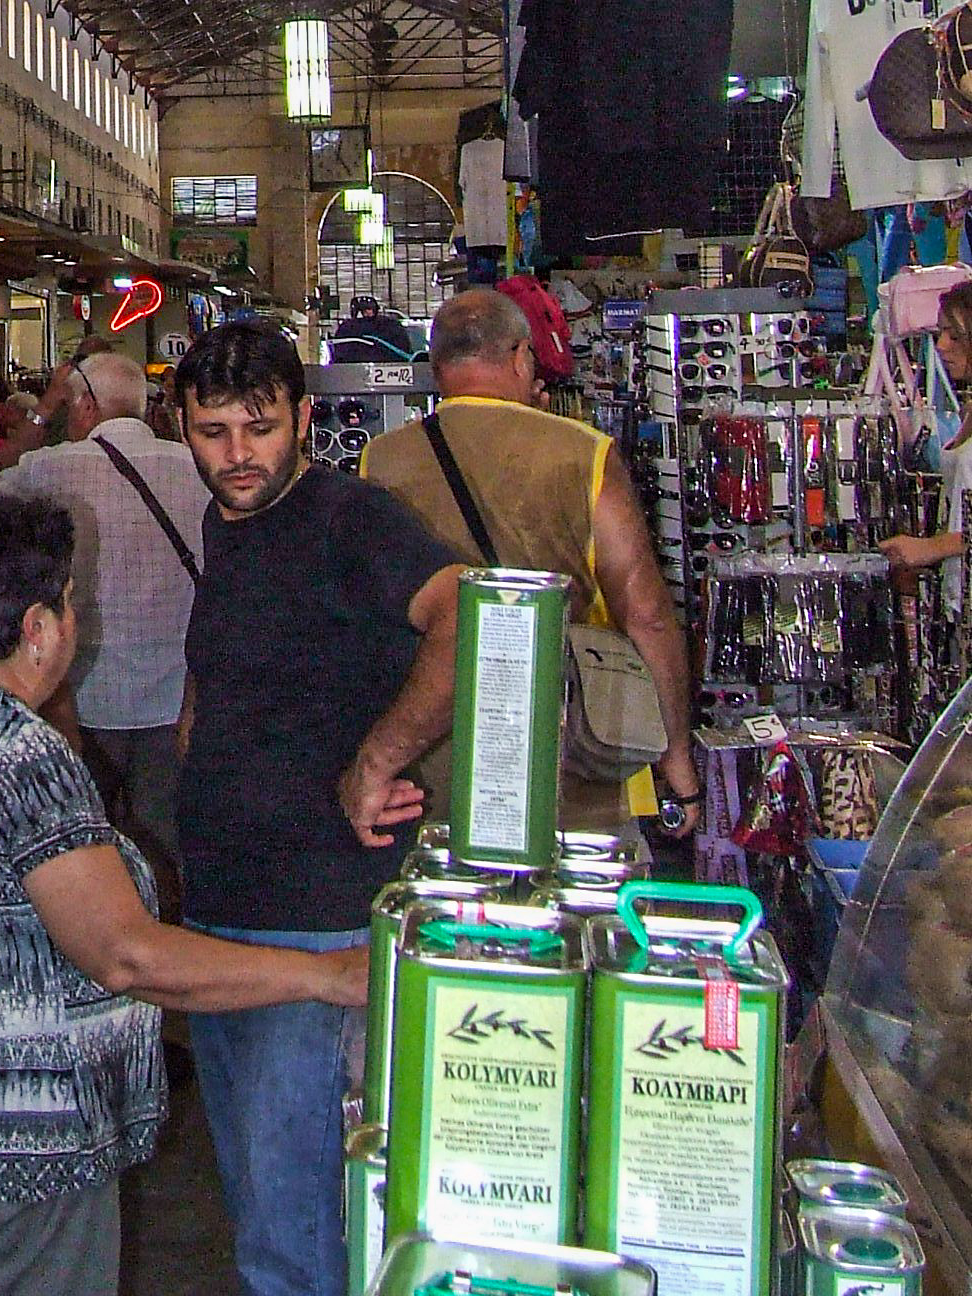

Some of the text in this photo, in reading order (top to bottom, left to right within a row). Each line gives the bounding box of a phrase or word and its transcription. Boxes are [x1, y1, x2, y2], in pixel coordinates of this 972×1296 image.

[167, 340, 185, 356] 10
[374, 369, 385, 383] 2
[443, 1061, 557, 1089] KOLYMVARI
[632, 1076, 748, 1105] ΚΟΛΥΜΒΑΡΙ
[439, 1175, 553, 1204] KOLYMVARI
